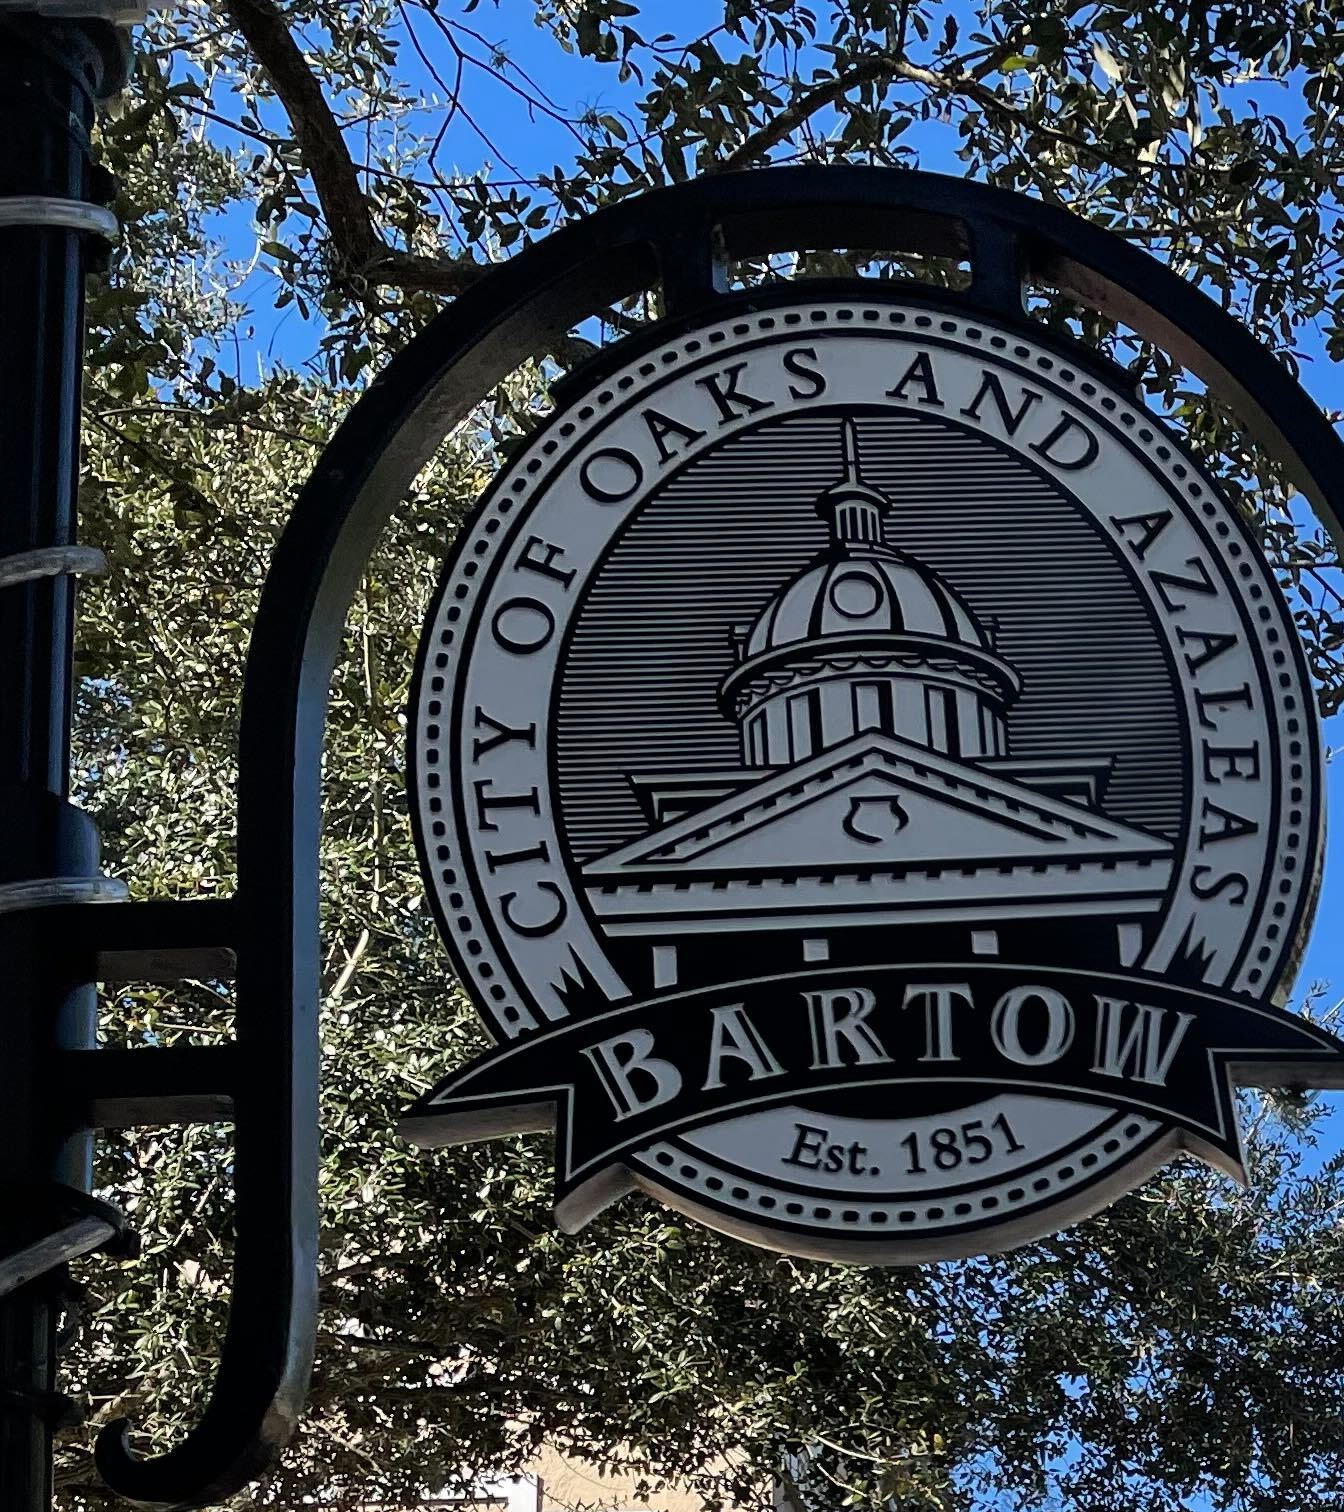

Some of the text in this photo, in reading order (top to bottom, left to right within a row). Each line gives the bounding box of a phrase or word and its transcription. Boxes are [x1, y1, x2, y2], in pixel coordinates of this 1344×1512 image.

[471, 348, 1263, 941] CITY OF OAKS AND AZALEAS
[578, 981, 1199, 1123] BARTOW
[780, 1113, 1027, 1176] Est. 1851
